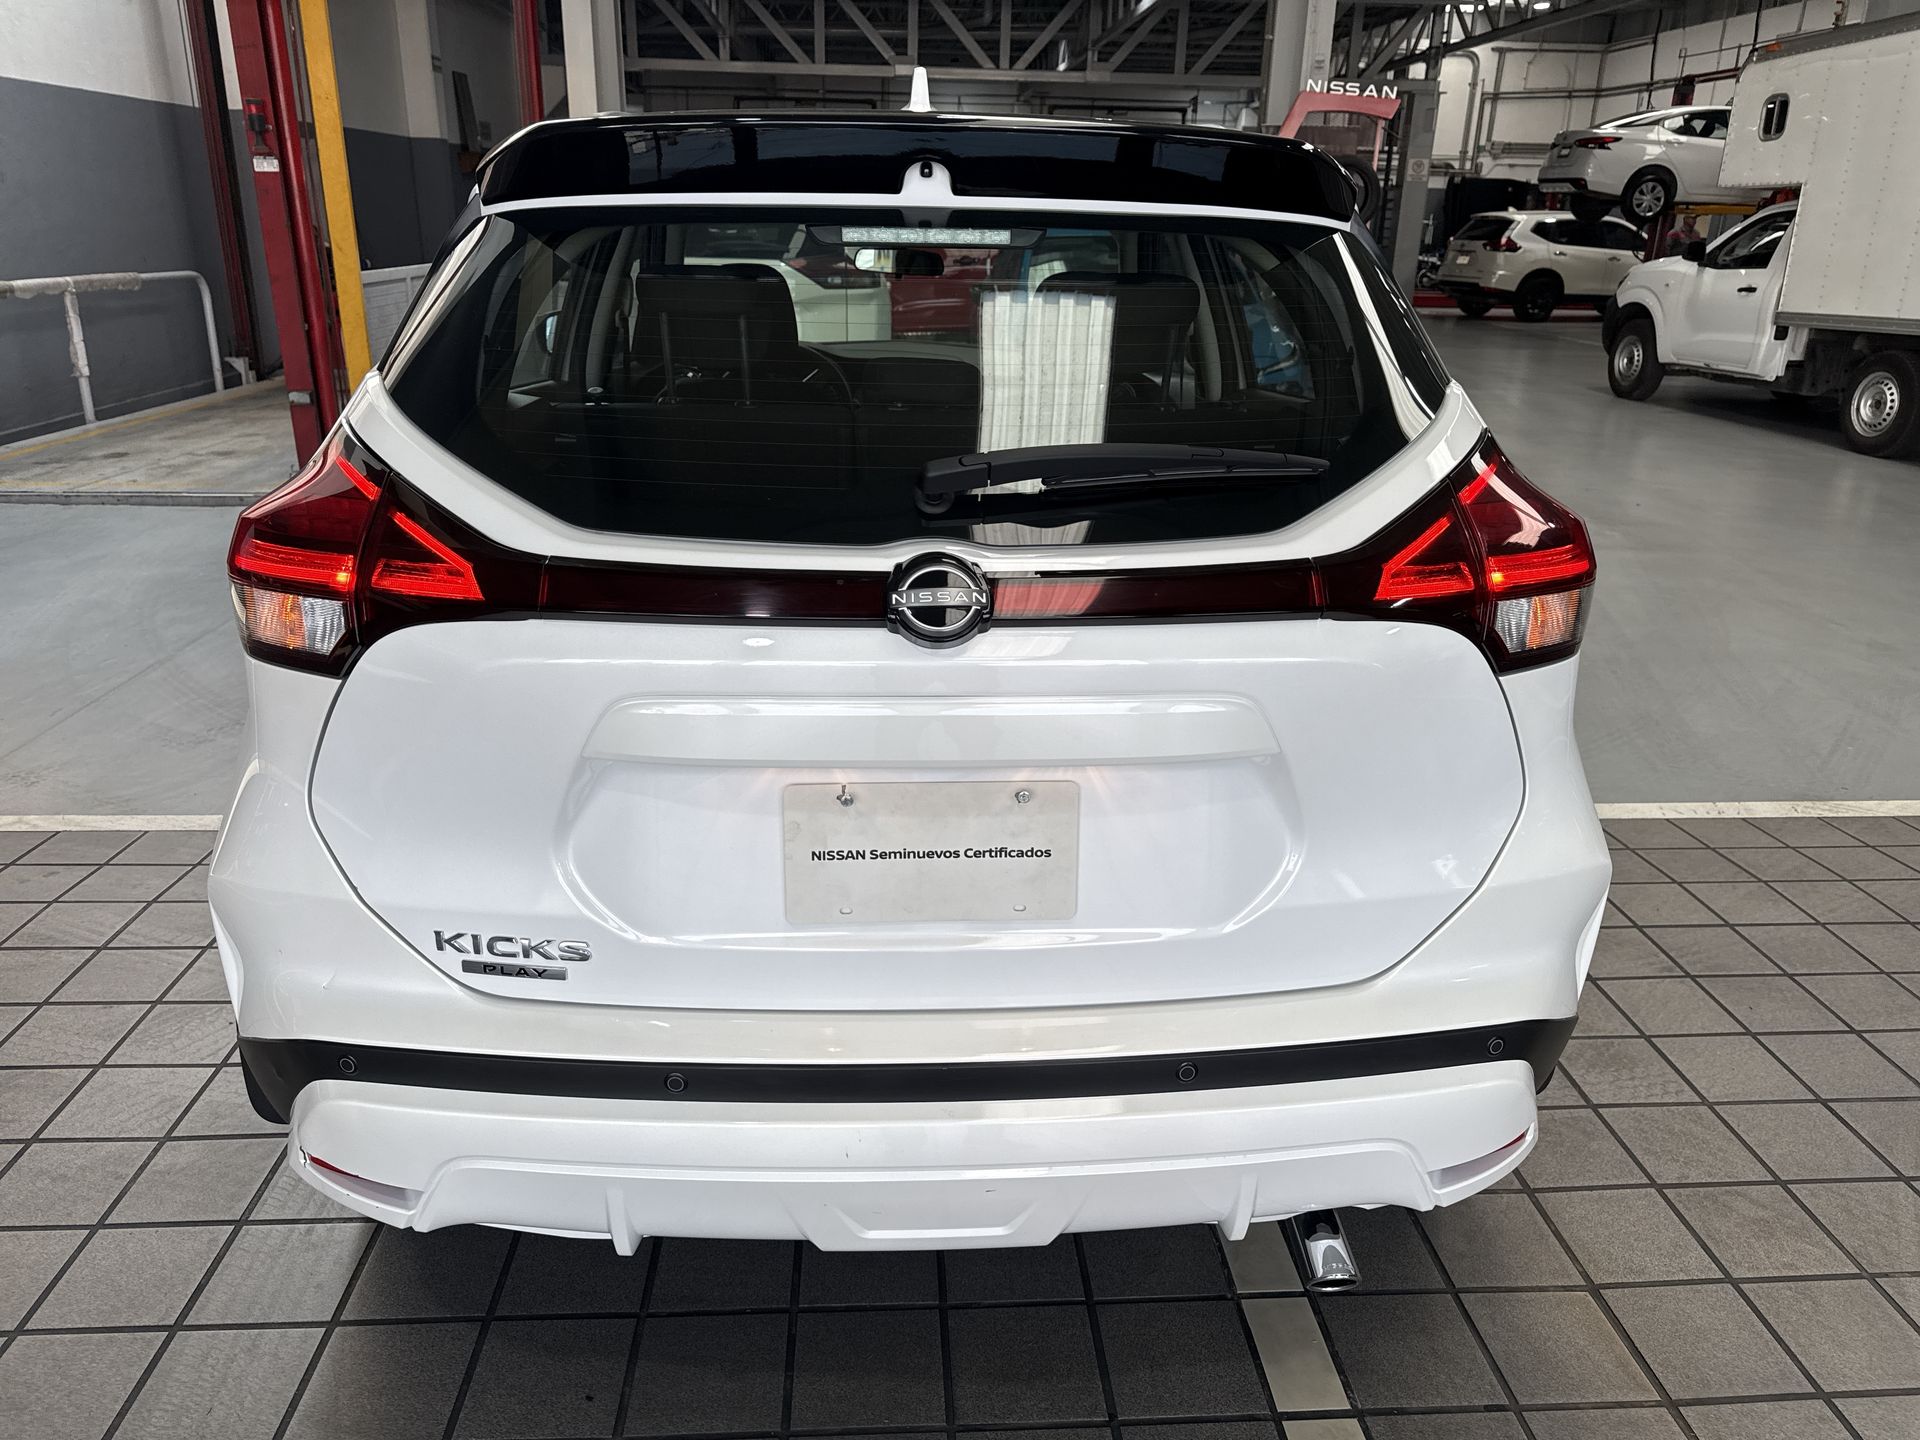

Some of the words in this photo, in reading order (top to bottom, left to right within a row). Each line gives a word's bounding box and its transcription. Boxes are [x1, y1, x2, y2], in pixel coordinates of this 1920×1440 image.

[1306, 79, 1398, 99] NISSAN
[892, 591, 987, 605] NISSAN
[811, 849, 867, 861] NISSAN
[869, 848, 961, 860] Seminuevos
[963, 847, 1052, 859] Certificados
[433, 930, 593, 962] KICKS
[482, 964, 549, 978] PLAY
